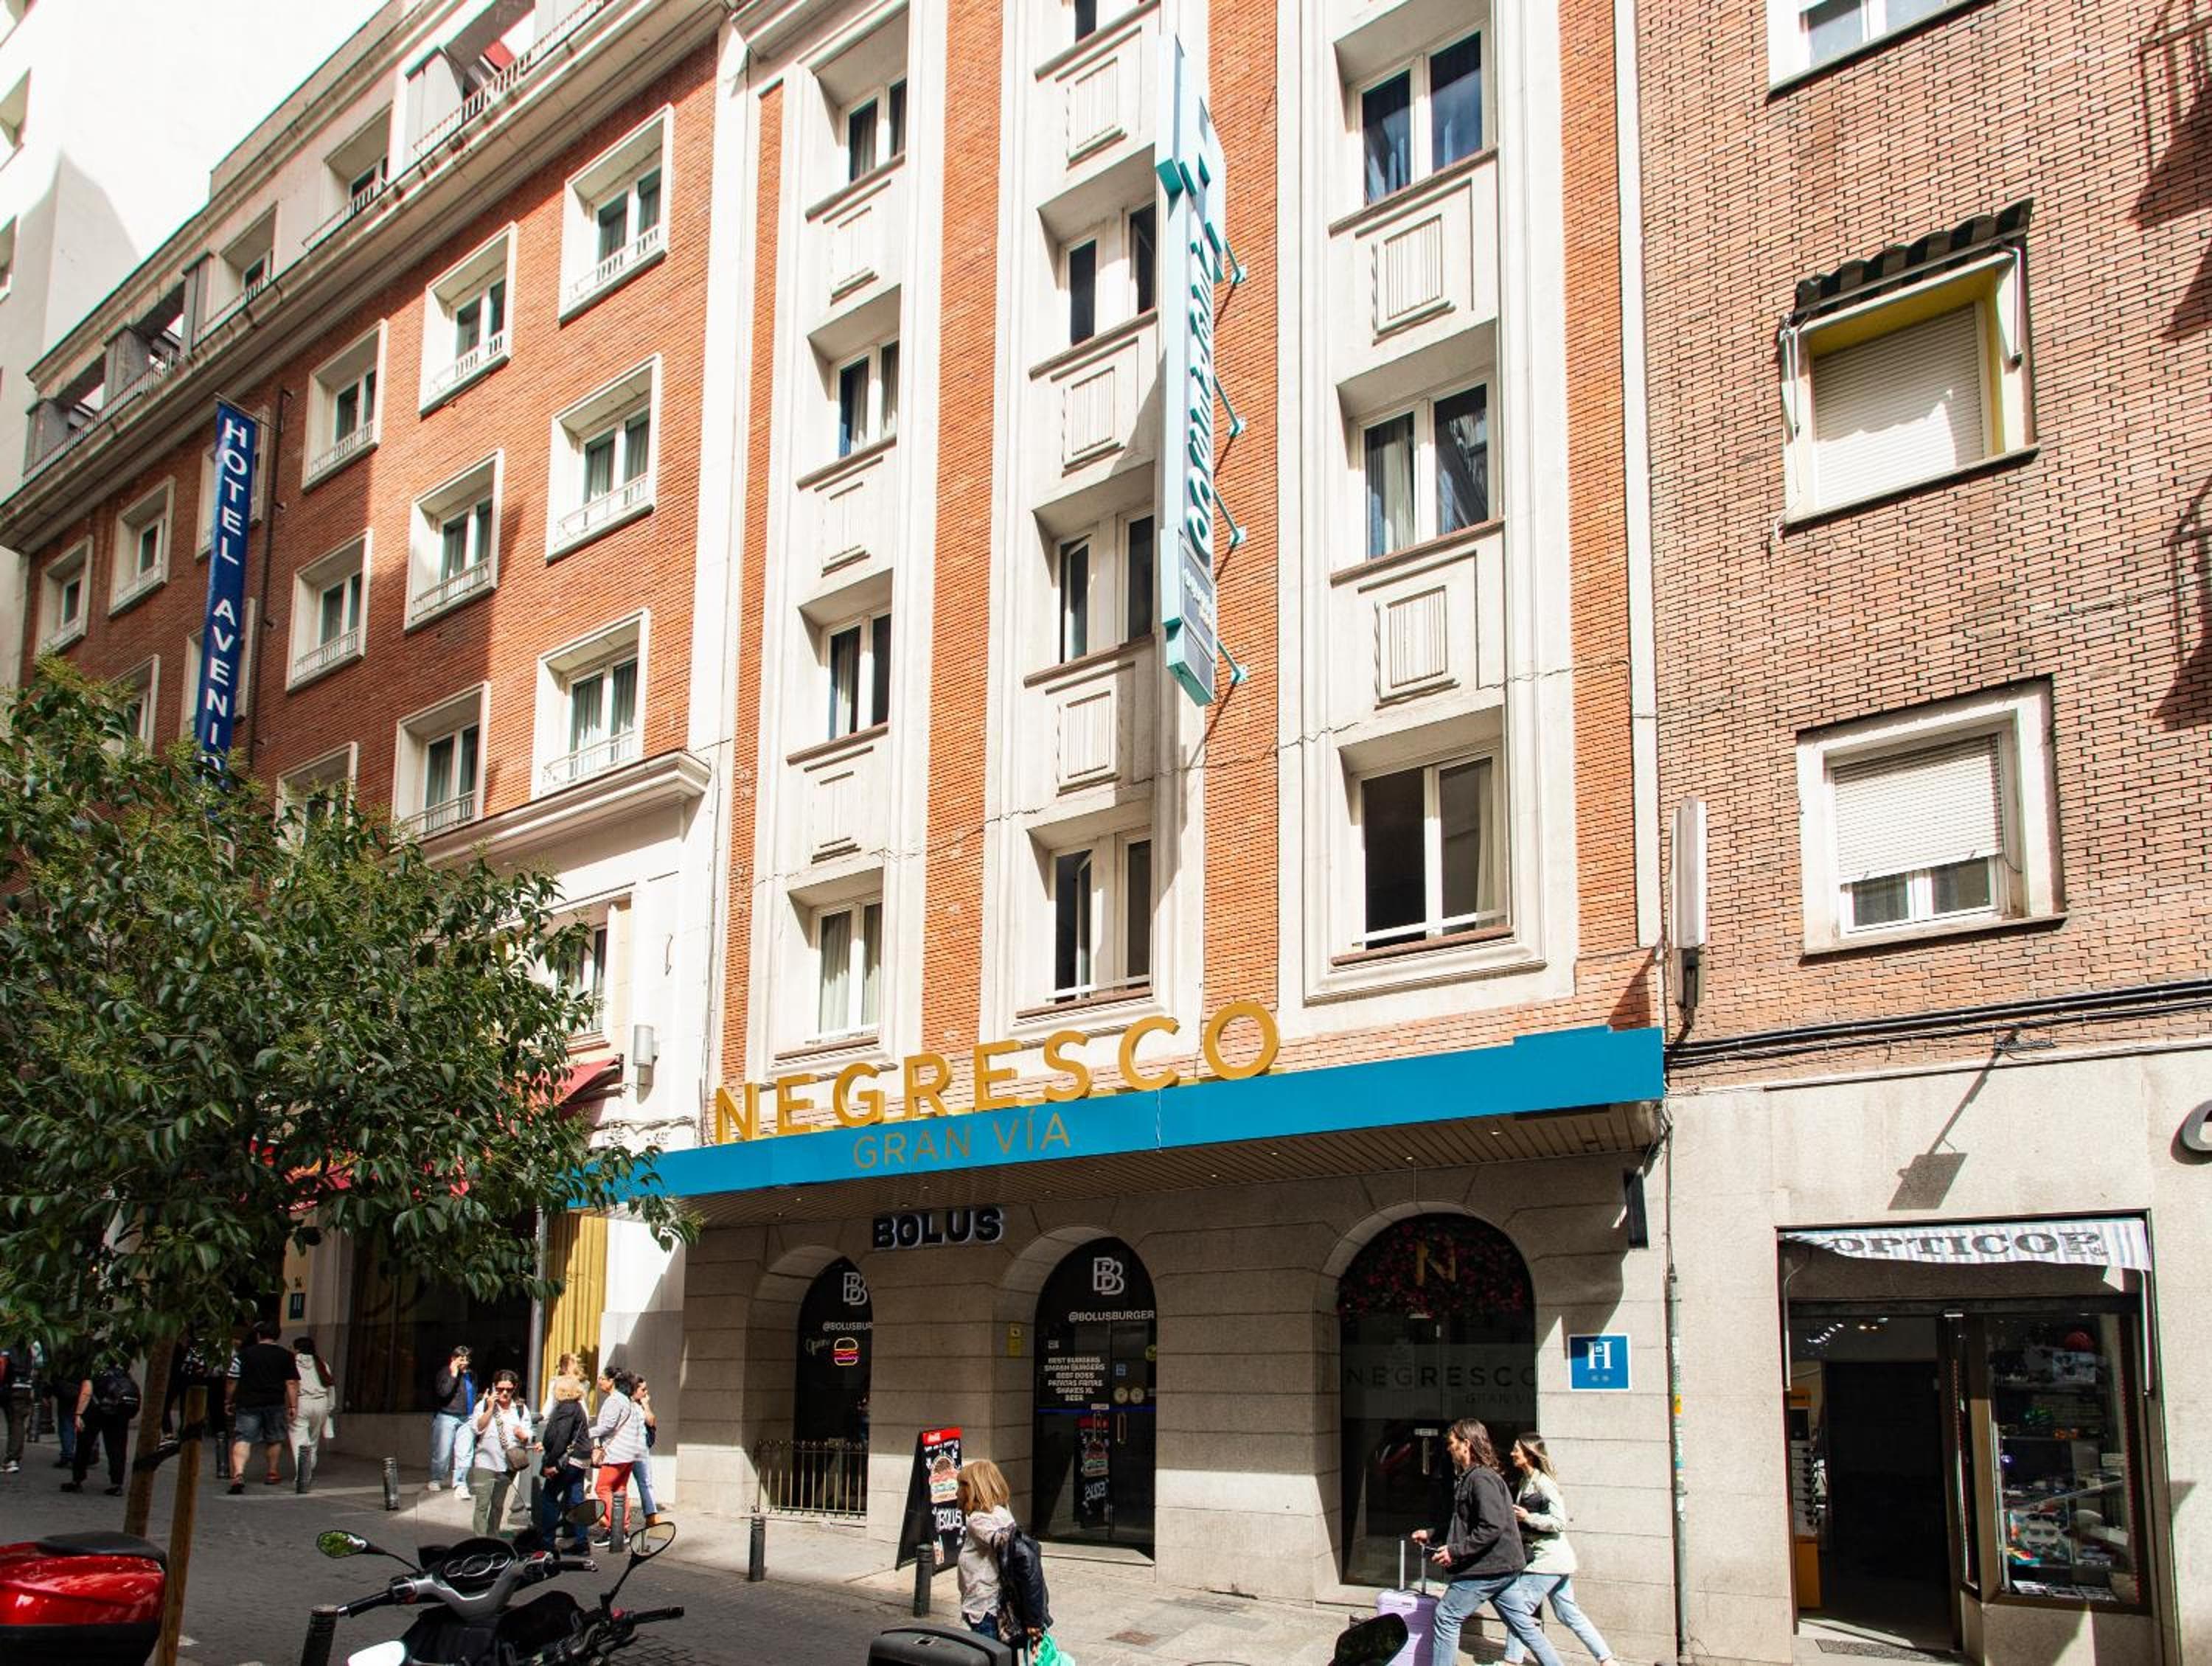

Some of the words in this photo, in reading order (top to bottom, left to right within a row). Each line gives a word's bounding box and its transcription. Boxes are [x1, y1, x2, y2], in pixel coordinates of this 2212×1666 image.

[222, 417, 248, 565] HOTEL
[714, 1001, 1281, 1144] NEGRESCO
[853, 1126, 971, 1169] GRAN
[993, 1109, 1071, 1154] VÍA
[872, 1206, 1004, 1250] BOLUS
[1415, 1240, 1457, 1286] N
[1068, 1310, 1155, 1322] @BOLUSBURGER
[1345, 1366, 1536, 1388] NEGRESCO
